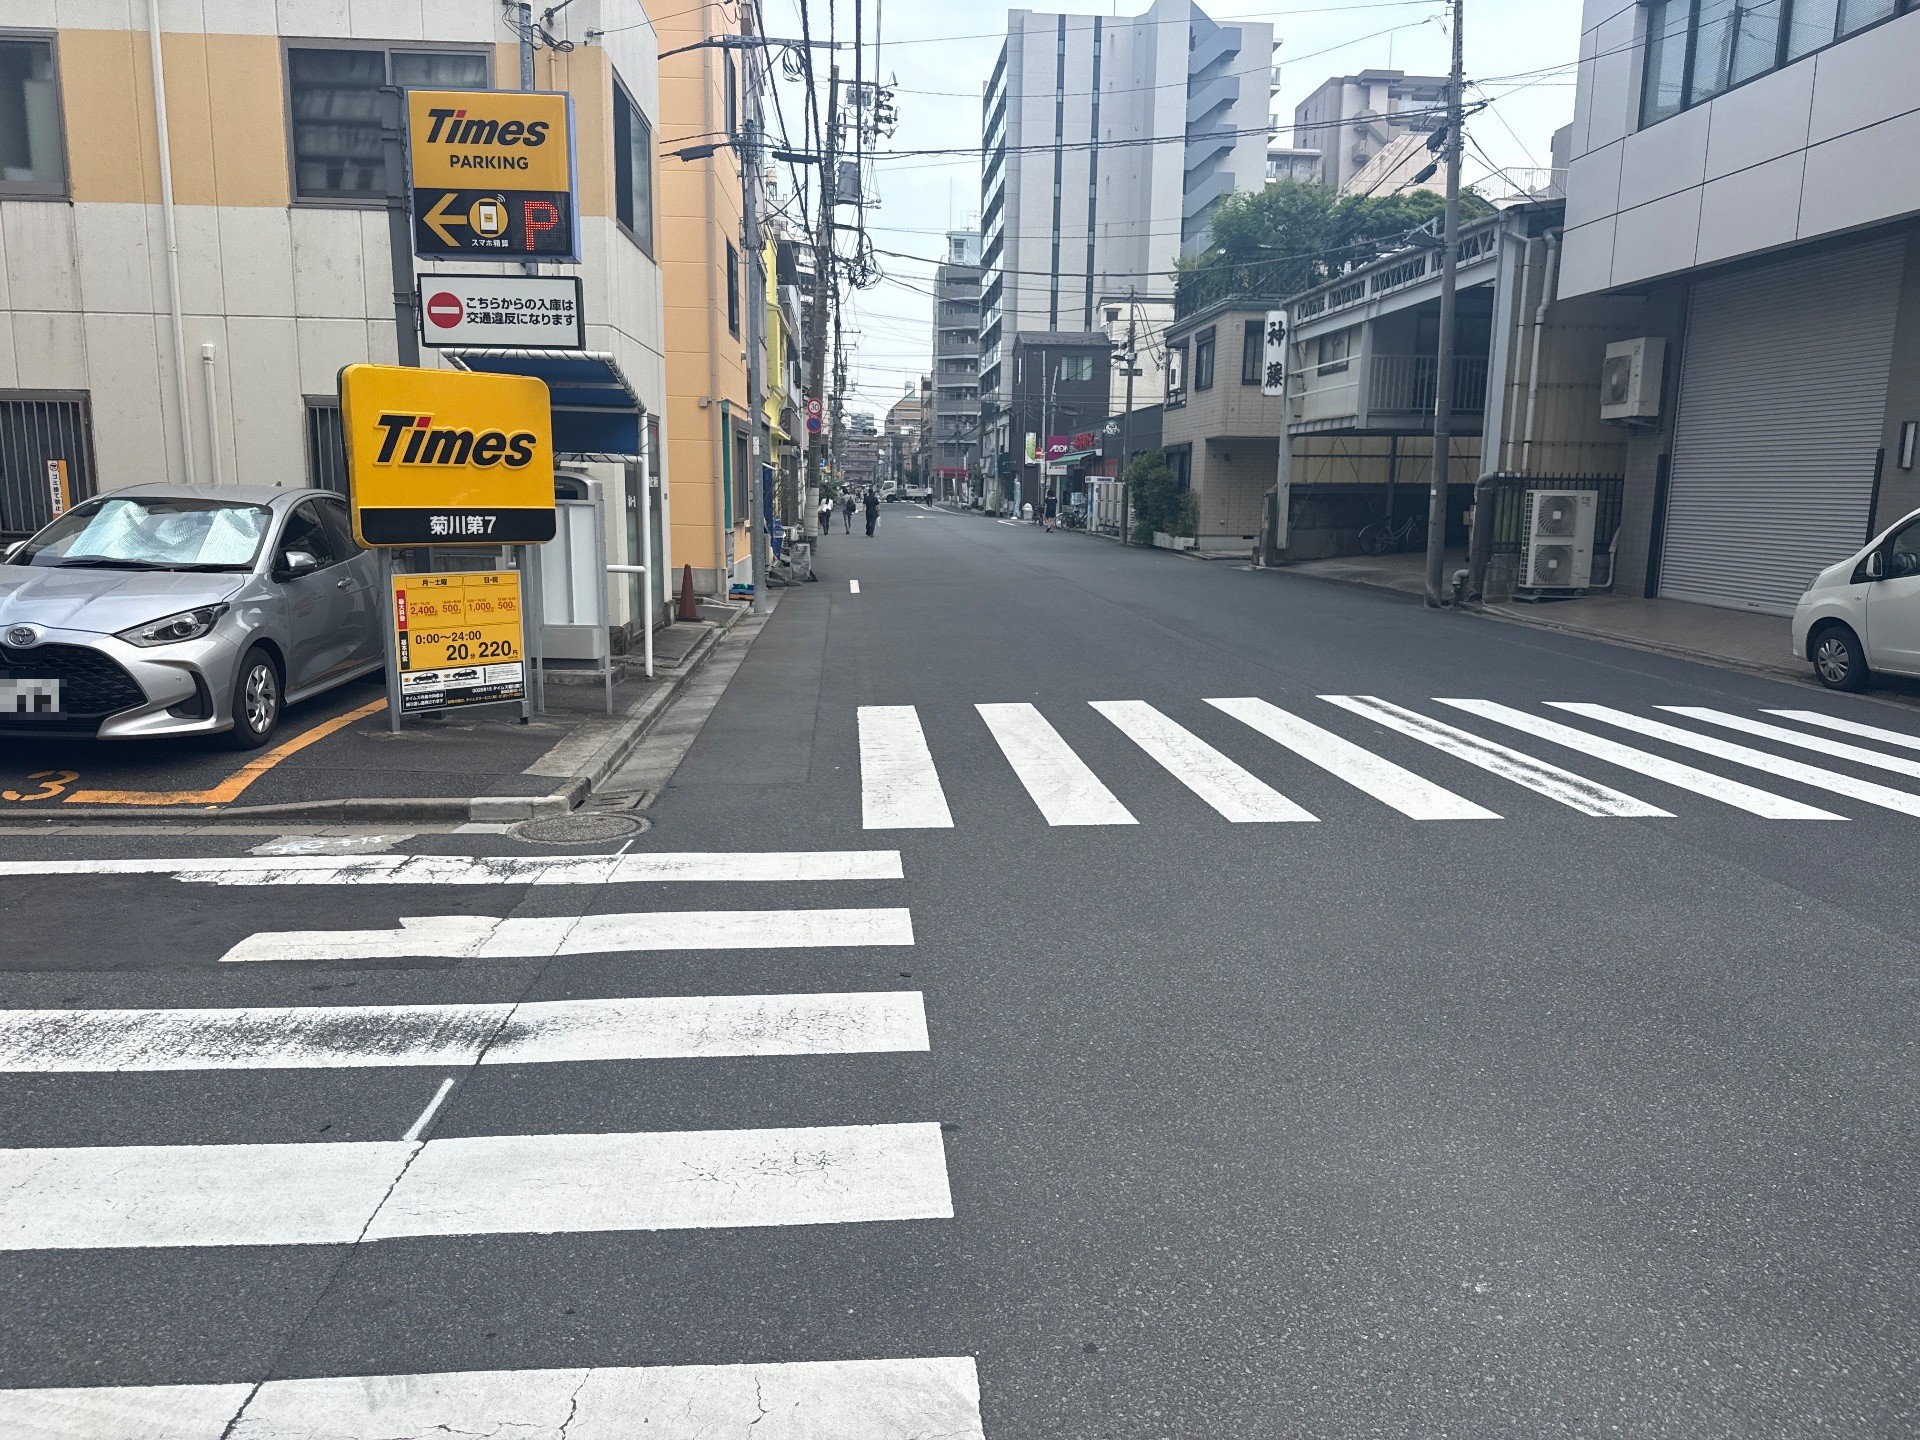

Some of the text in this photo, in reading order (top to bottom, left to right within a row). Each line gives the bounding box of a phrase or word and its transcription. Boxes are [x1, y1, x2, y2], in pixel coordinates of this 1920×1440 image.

[427, 108, 549, 147] Times
[450, 154, 529, 170] PARKING
[524, 200, 558, 251] P
[471, 239, 509, 248] スマホ精算
[466, 297, 574, 312] こちらからの入庫は
[466, 311, 576, 327] 交通違反になります
[377, 413, 537, 467] Times
[429, 515, 497, 536] 菊川第7
[415, 630, 482, 645] 0:00～24:00
[2, 770, 80, 801] 3
